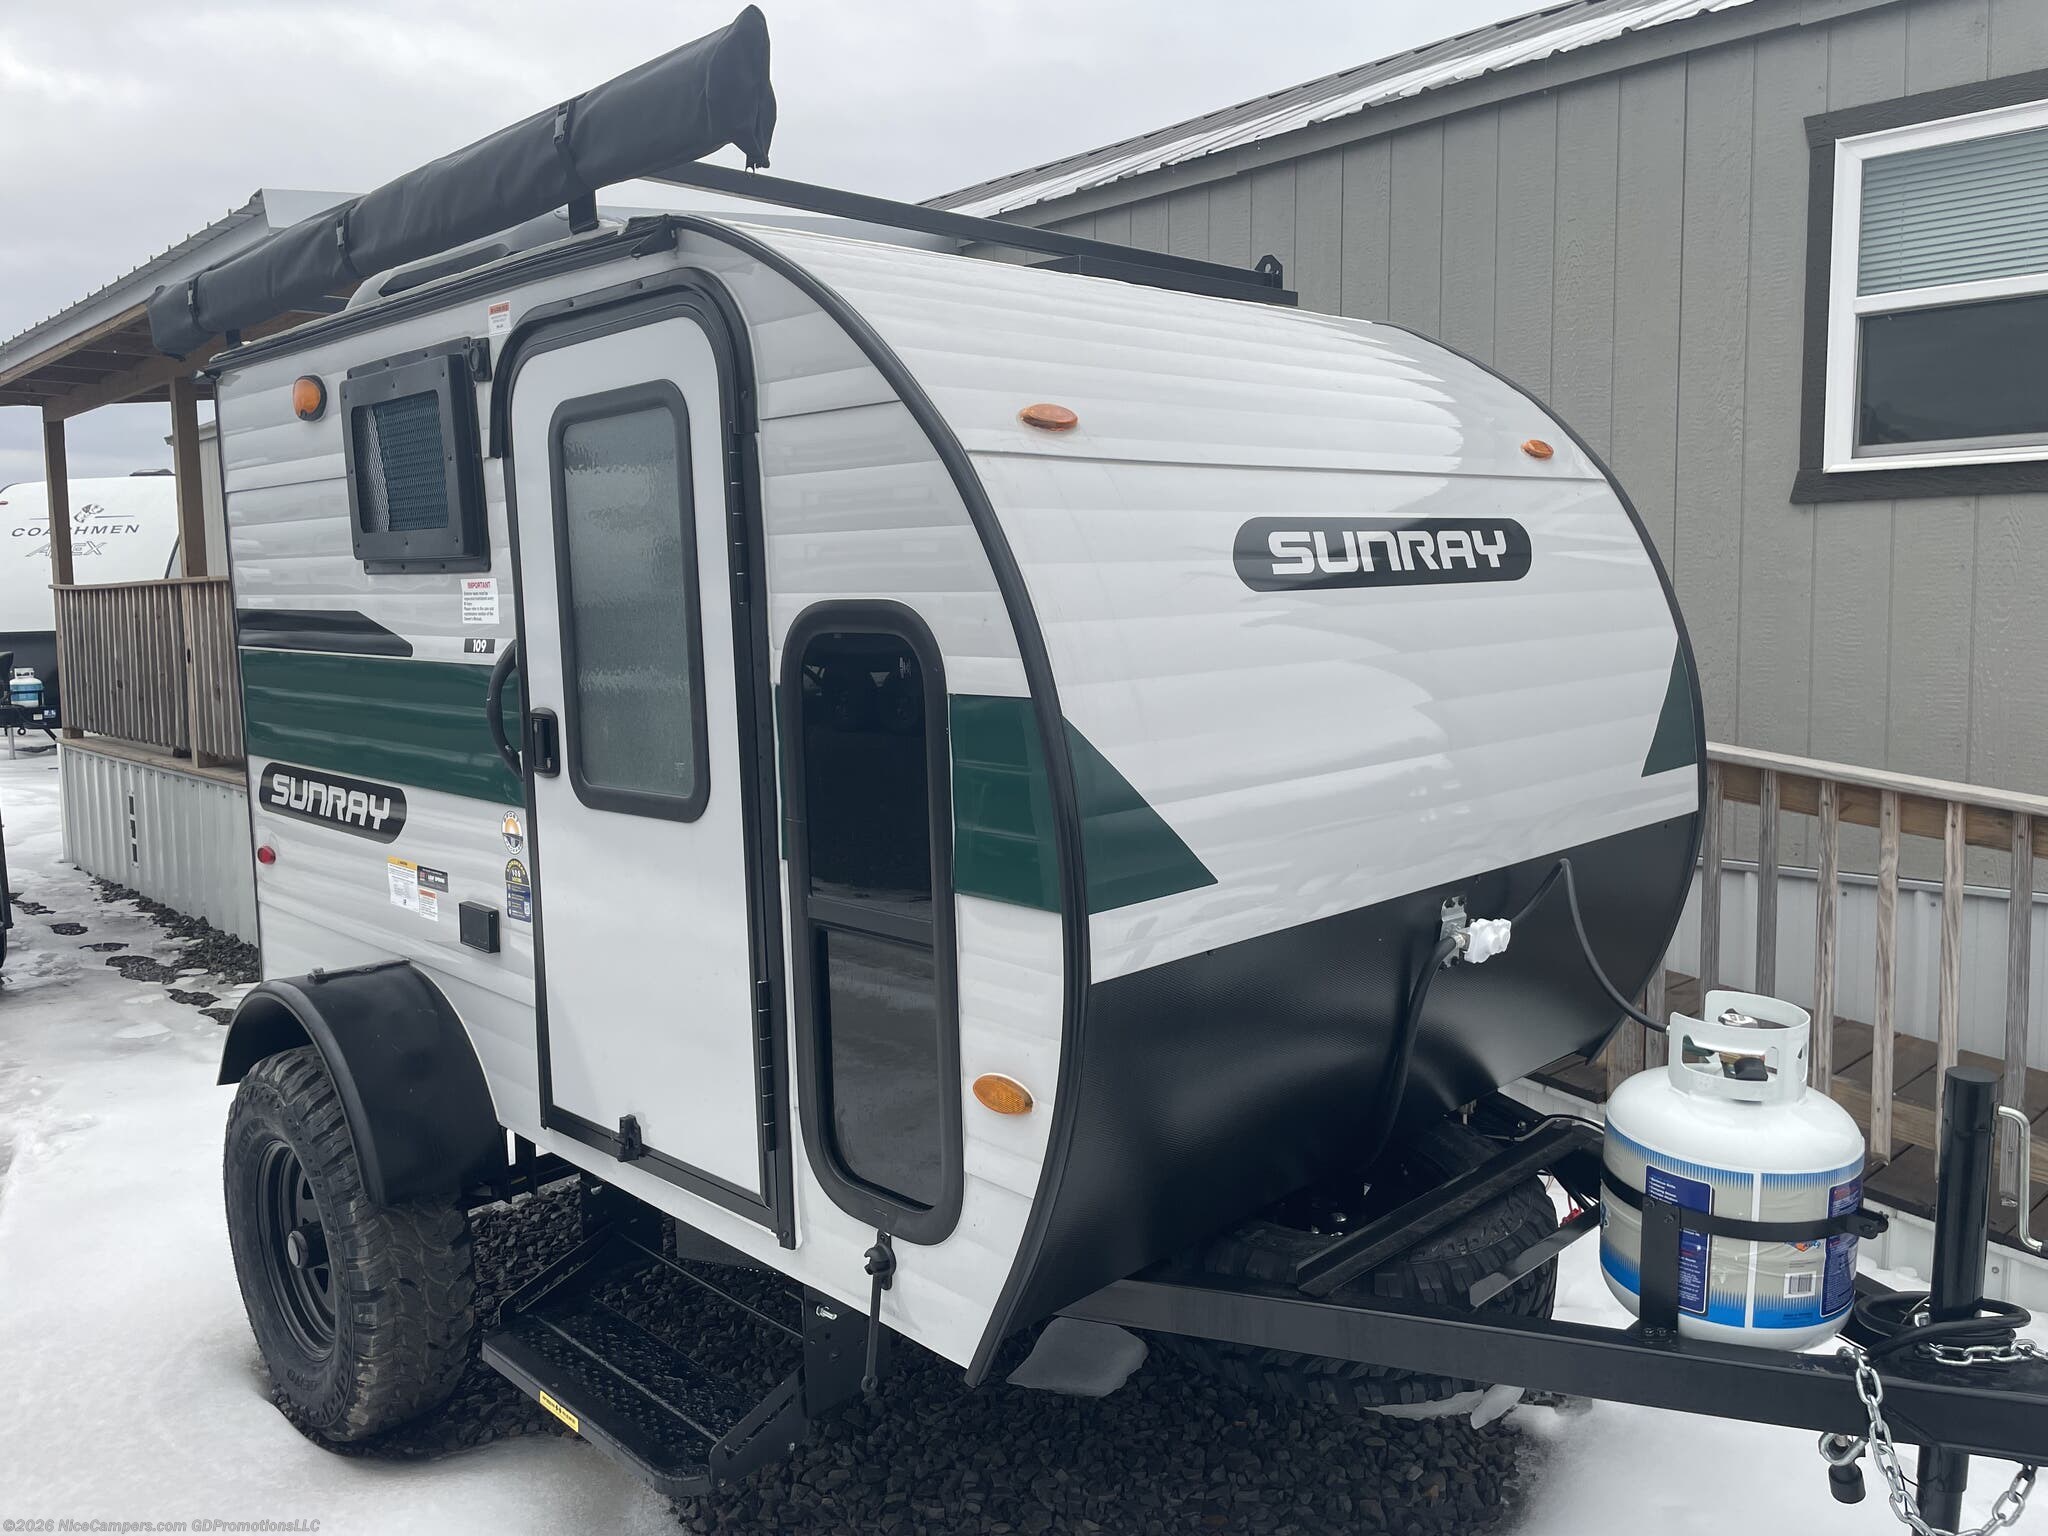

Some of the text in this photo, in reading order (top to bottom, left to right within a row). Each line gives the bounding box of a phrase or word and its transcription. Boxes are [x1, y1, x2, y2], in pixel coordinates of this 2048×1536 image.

[11, 525, 140, 537] COAHMEN
[25, 541, 107, 557] AEX
[1267, 530, 1507, 575] SUNRAY
[467, 581, 491, 589] IMPORTANT
[473, 639, 487, 653] 109
[271, 773, 391, 831] SUNRAY
